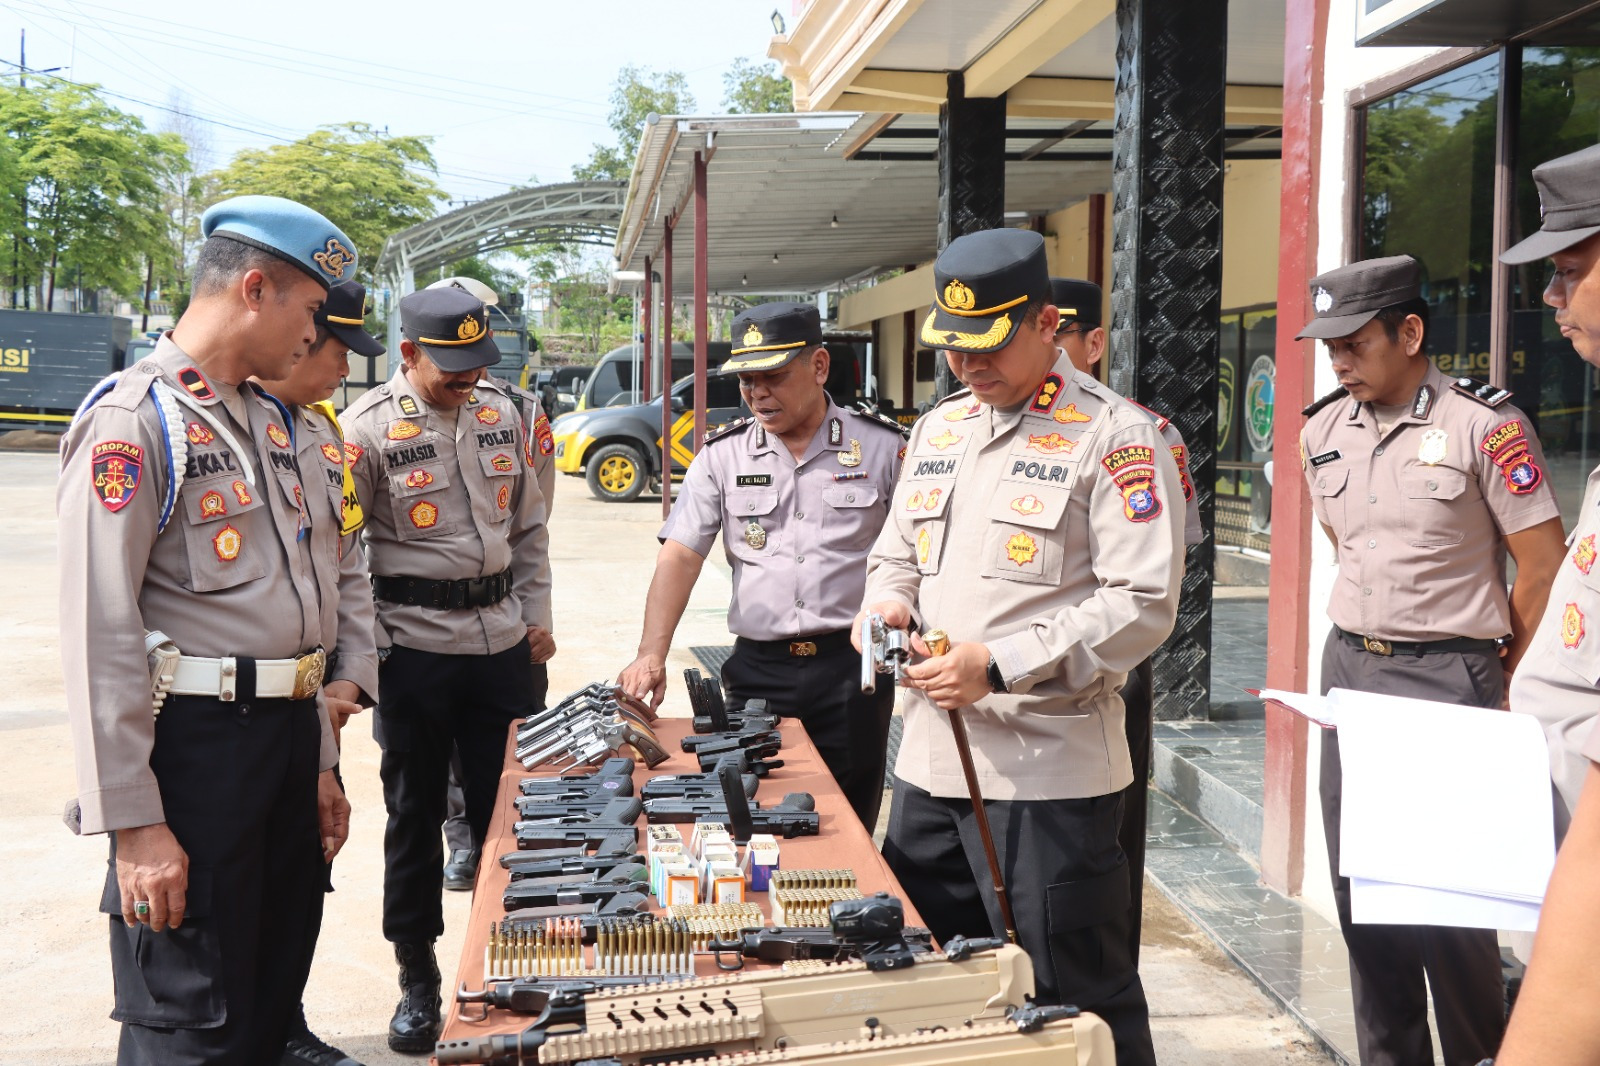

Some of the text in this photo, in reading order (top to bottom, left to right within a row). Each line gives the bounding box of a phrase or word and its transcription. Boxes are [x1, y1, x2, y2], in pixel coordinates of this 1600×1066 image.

[476, 428, 515, 449] POLRI
[1484, 421, 1520, 451] POLRES
[95, 442, 140, 457] PROPAM
[386, 443, 438, 469] M.NASIR
[1104, 447, 1152, 466] POLRES
[913, 458, 957, 477] JOKO.H
[1011, 460, 1070, 484] POLRI
[1108, 454, 1152, 472] LAMANDAU
